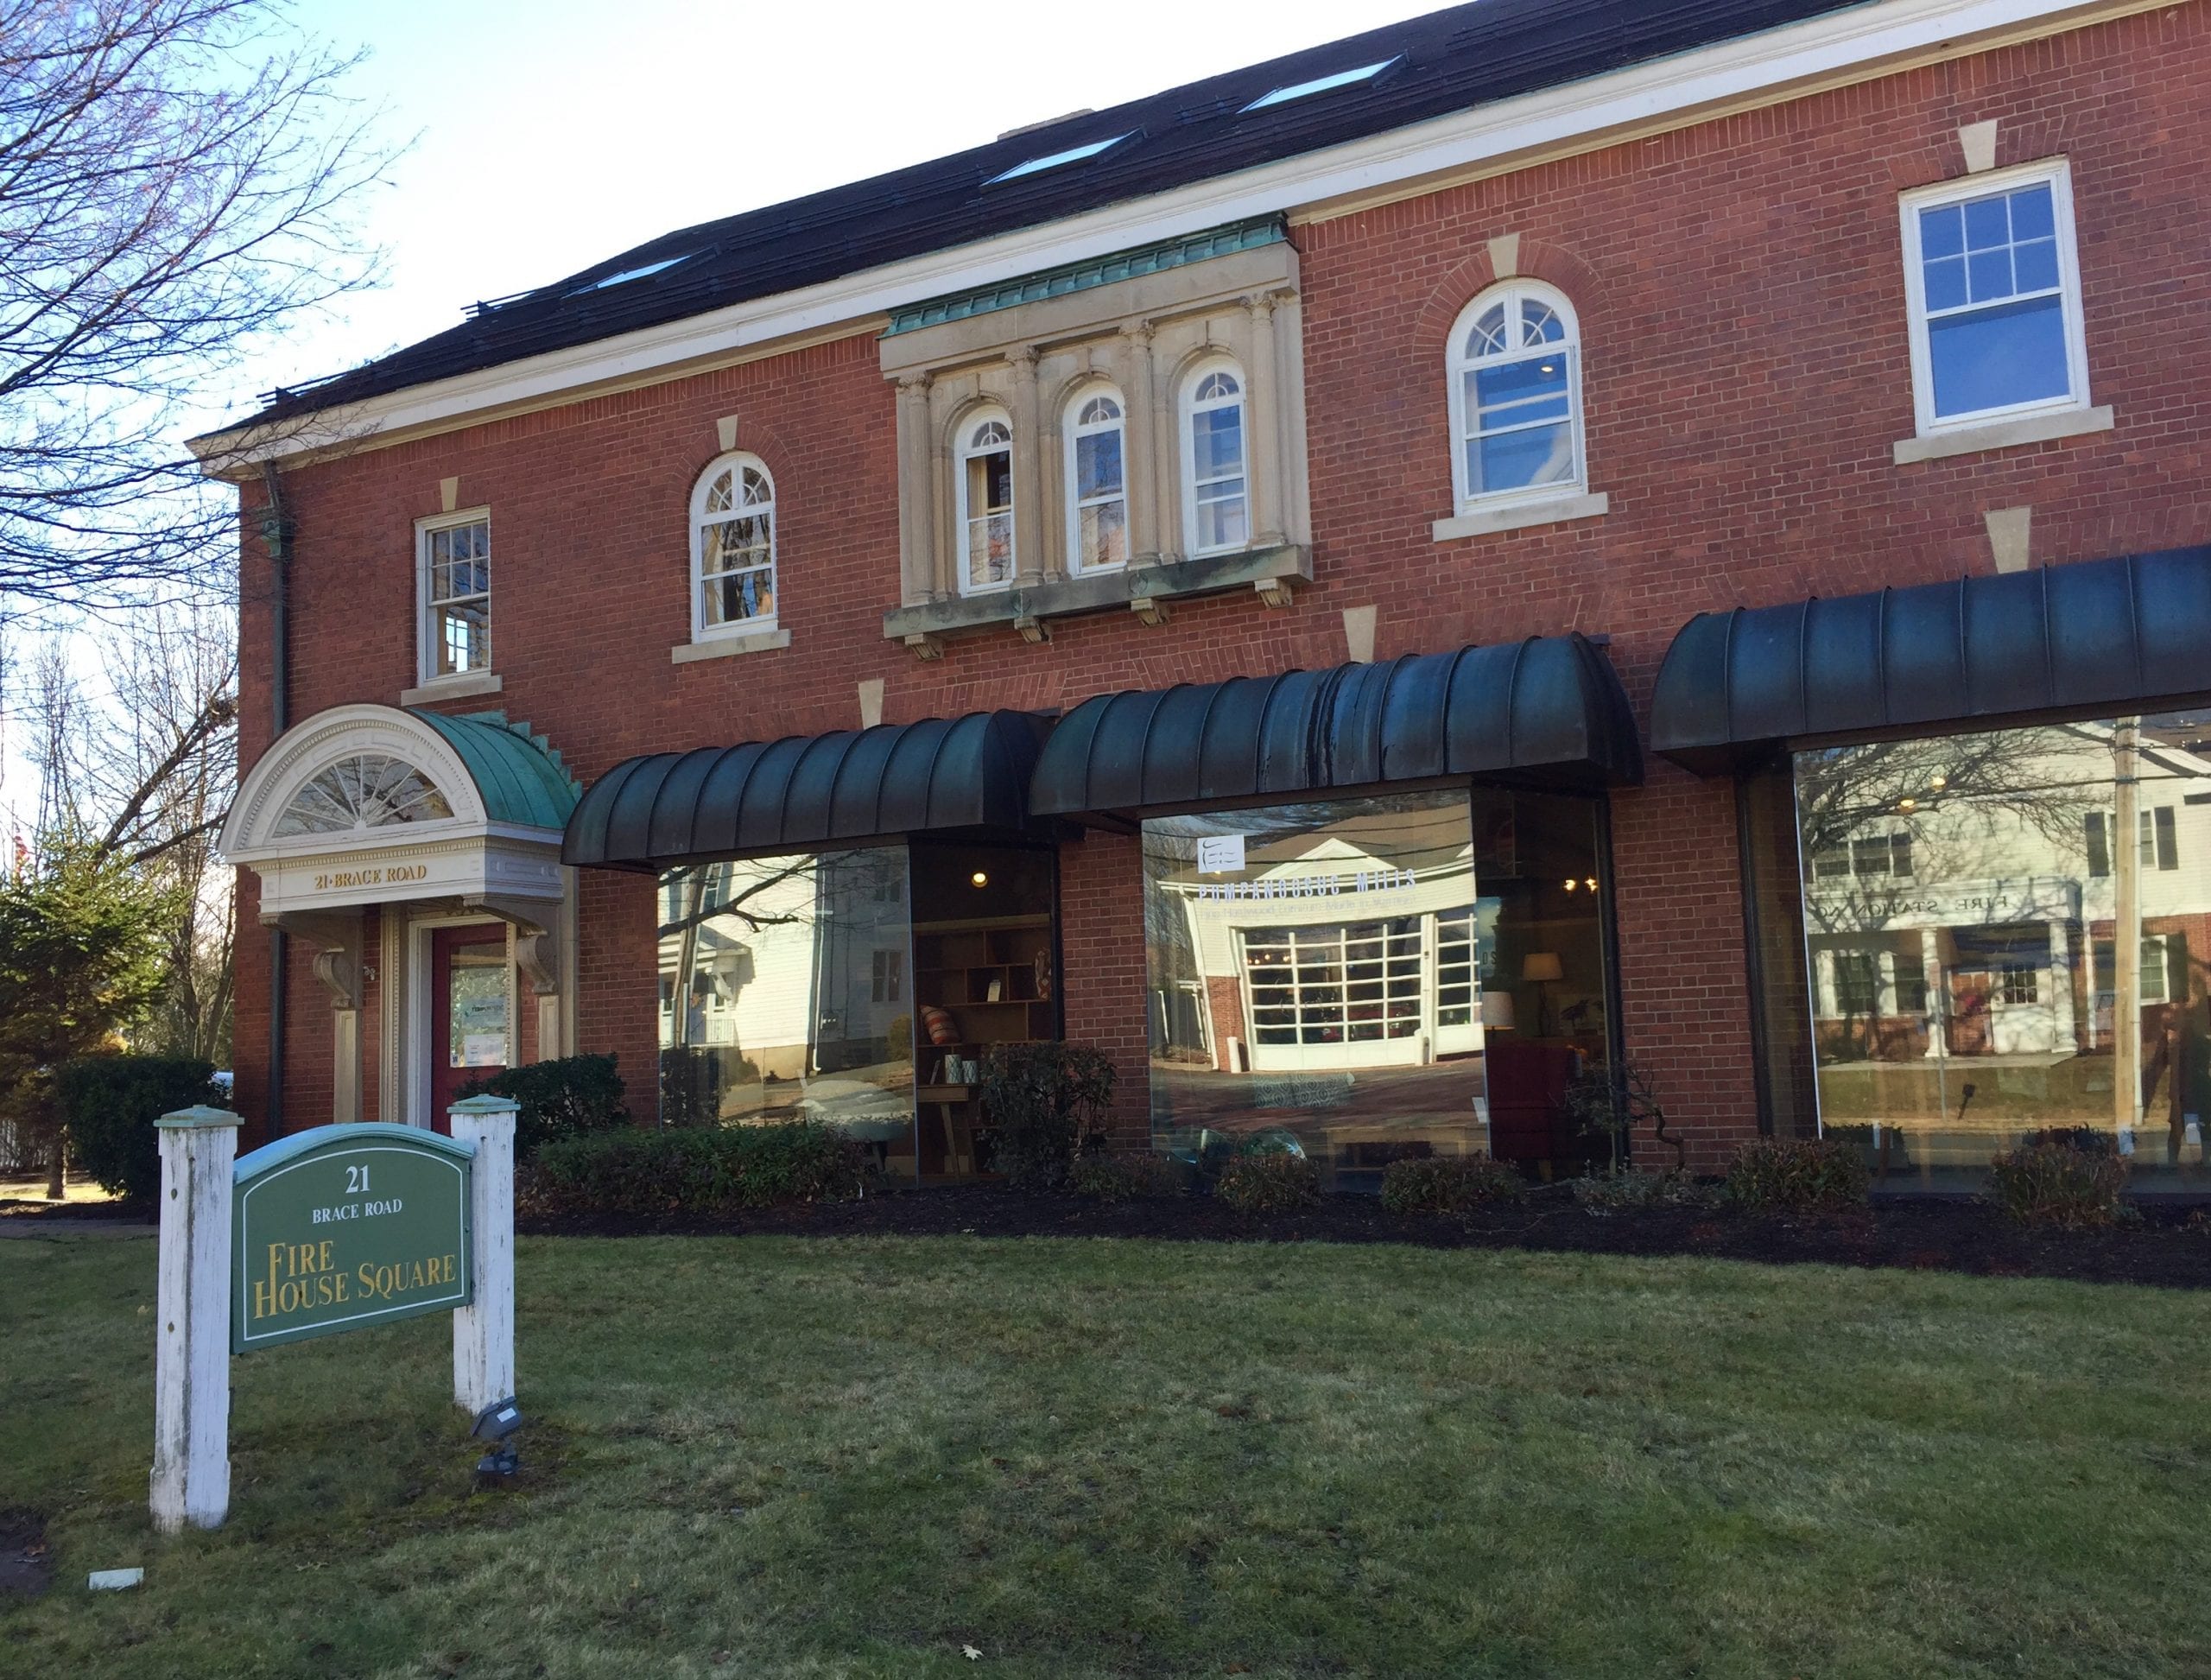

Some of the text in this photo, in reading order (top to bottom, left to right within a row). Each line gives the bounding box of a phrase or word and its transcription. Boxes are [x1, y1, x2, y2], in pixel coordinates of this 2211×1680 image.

[386, 865, 428, 882] ROAD
[1356, 868, 1416, 893] MILLS
[345, 1164, 371, 1194] 21
[312, 1198, 402, 1224] BRACE ROAD
[253, 1254, 456, 1320] HOUSE SQUARE
